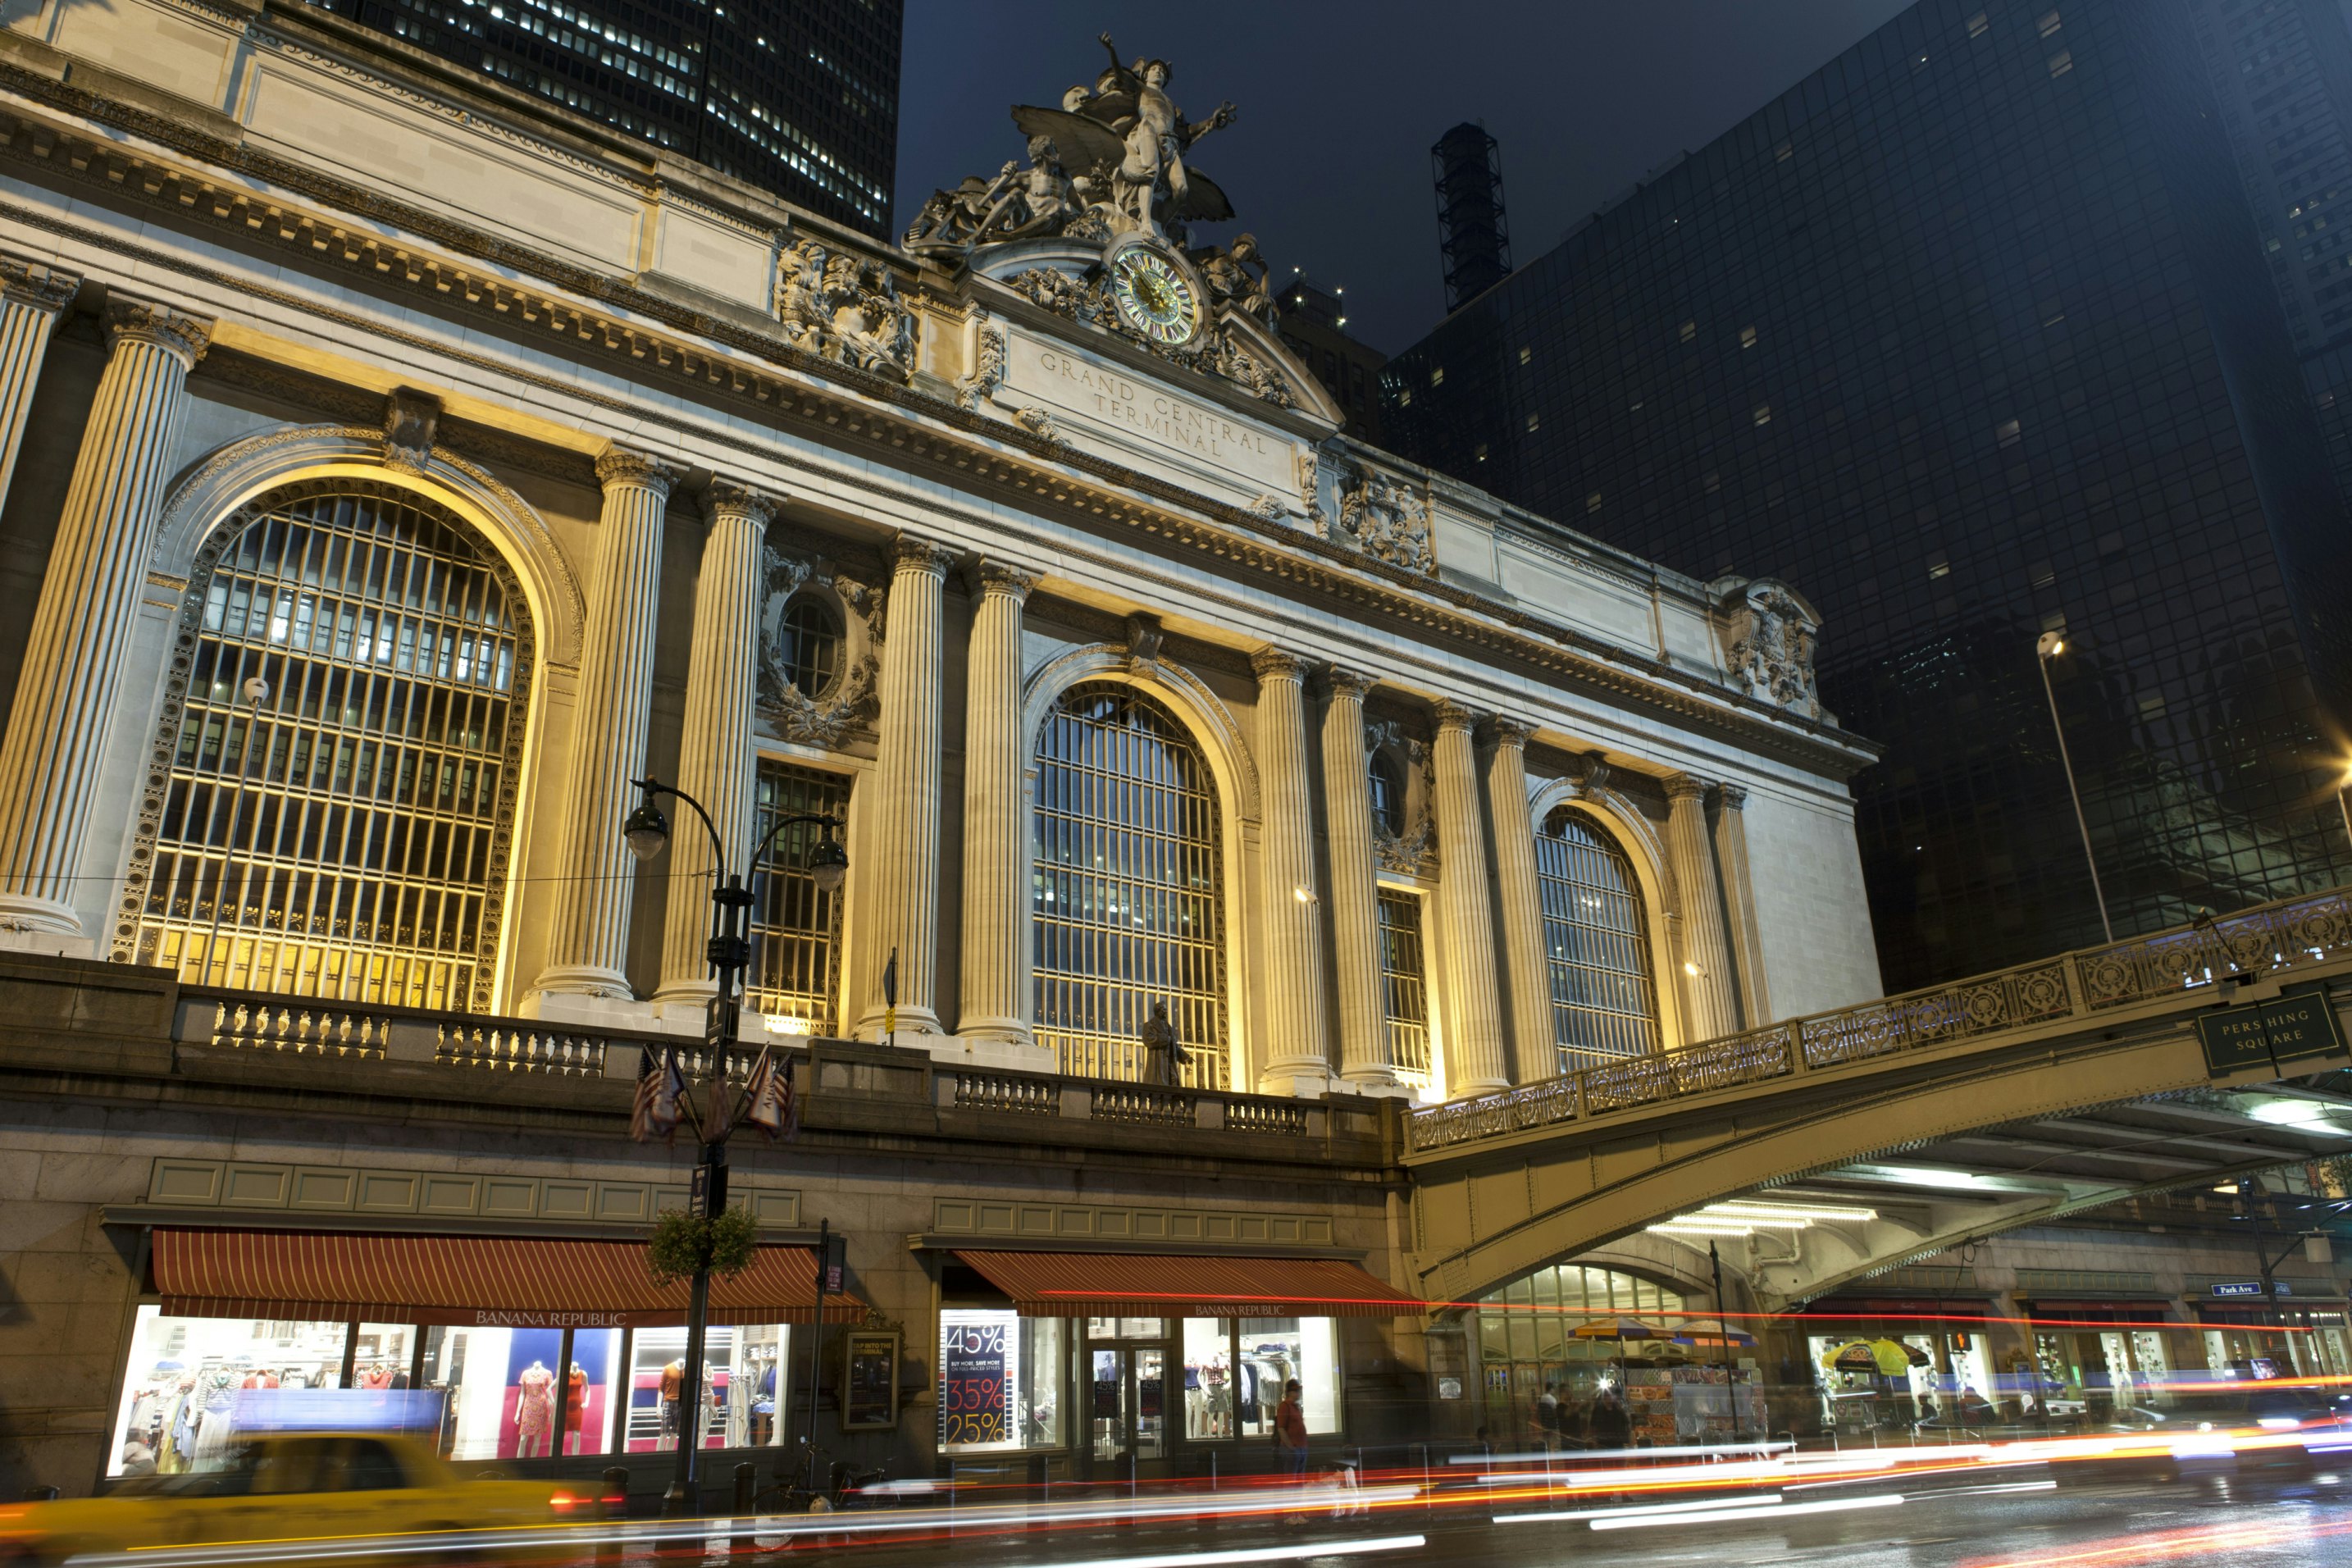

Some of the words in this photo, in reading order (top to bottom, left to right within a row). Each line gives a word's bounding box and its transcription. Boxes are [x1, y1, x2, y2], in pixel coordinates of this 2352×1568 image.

[1041, 353, 1134, 401] GRAND
[1154, 398, 1267, 454] CENTRAL
[1094, 394, 1222, 457] TERMINAL
[2222, 1010, 2309, 1035] PERSHING
[2236, 1030, 2303, 1050] SQUARE
[476, 1310, 545, 1325] BANANA
[549, 1312, 627, 1326] REPUBLIC
[1196, 1305, 1237, 1315] BANANA
[1238, 1305, 1285, 1315] REPUBLIC
[946, 1325, 1005, 1354] 45%
[946, 1379, 1005, 1411] 35%
[1096, 1381, 1115, 1391] 45%
[1142, 1380, 1160, 1389] 45%
[946, 1412, 1005, 1445] 25%
